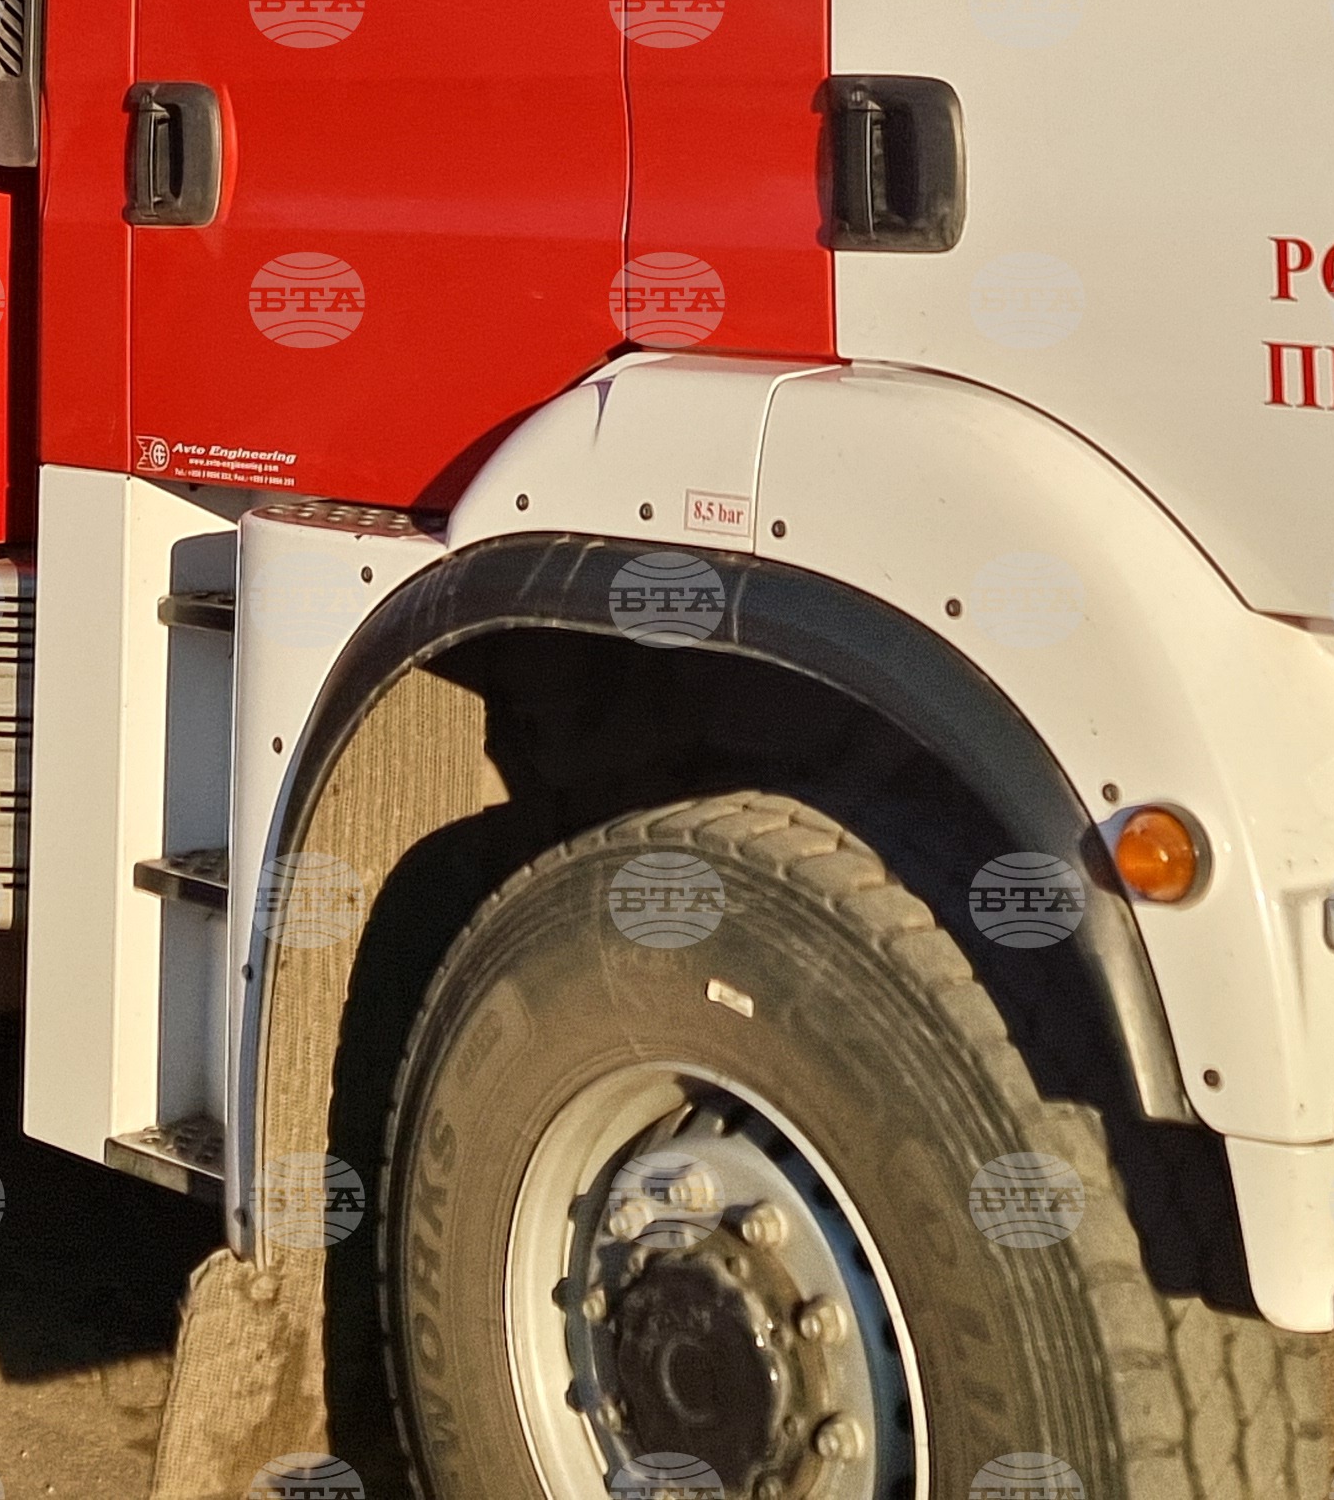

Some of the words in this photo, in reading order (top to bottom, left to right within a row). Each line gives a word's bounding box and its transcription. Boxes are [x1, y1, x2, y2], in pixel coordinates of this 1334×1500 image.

[172, 442, 205, 455] Avto
[209, 445, 297, 464] Engineering
[694, 500, 714, 524] 8,5
[719, 502, 744, 524] bar
